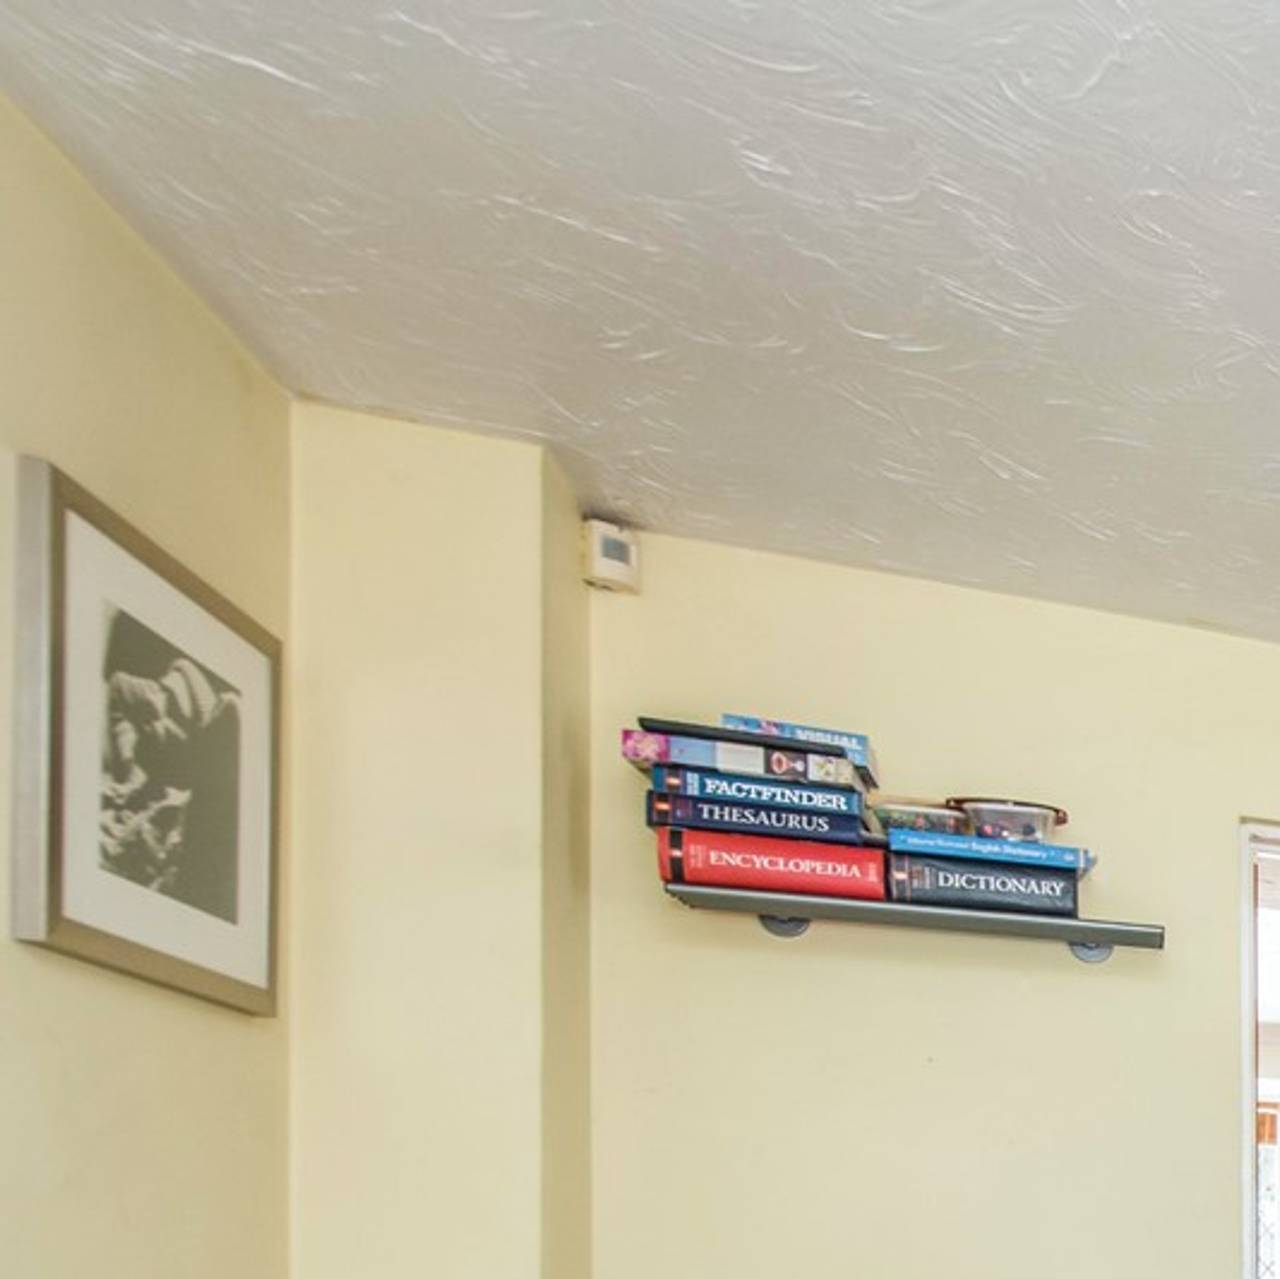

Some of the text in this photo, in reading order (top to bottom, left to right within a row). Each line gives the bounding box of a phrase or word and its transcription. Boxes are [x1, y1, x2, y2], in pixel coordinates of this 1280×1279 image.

[704, 777, 848, 810] FACTFINDER
[698, 803, 830, 832] THESAURUS
[709, 850, 862, 879] ENCYCLOPEDIA
[938, 871, 1065, 897] DICTIONARY
